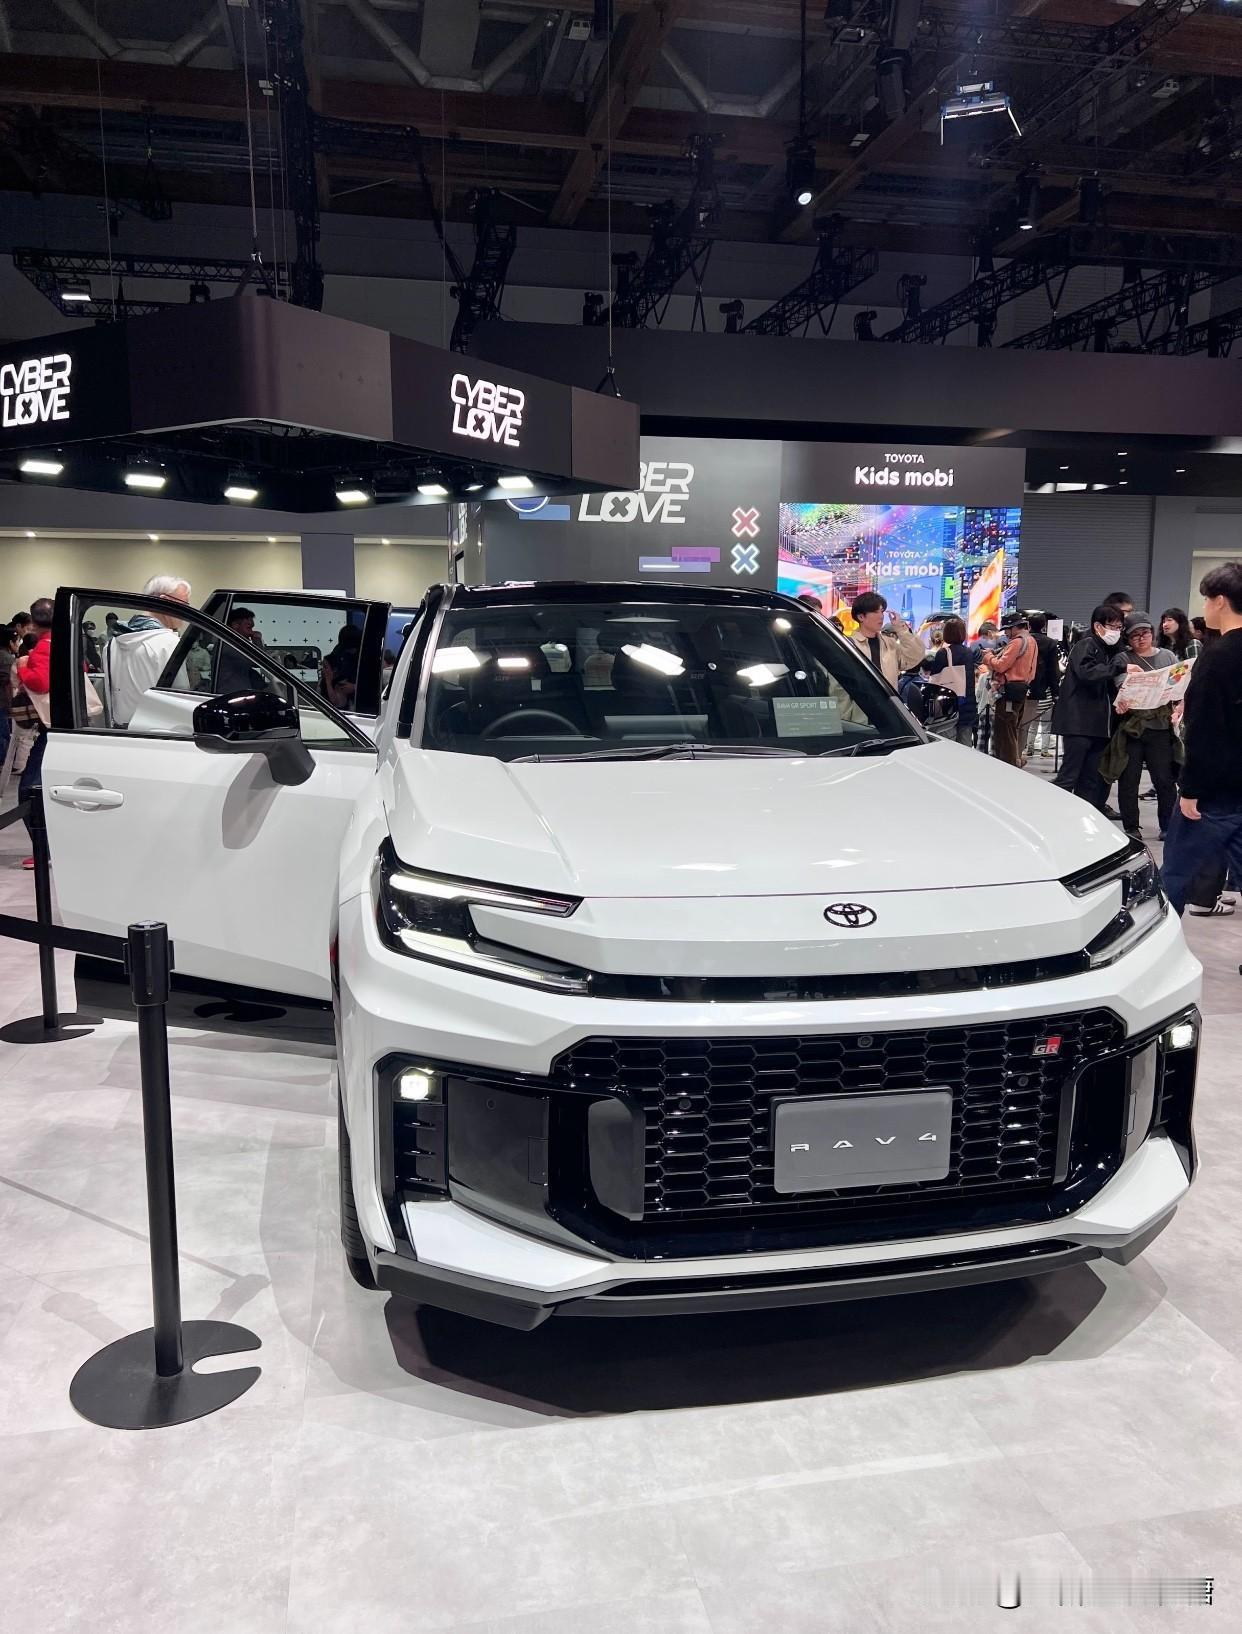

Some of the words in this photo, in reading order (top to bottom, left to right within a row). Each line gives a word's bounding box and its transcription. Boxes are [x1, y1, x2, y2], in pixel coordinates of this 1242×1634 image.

[0, 354, 72, 396] CYBER
[3, 386, 71, 427] LOVE
[451, 373, 525, 419] CYBER
[452, 403, 522, 447] LOVE
[884, 453, 925, 464] TOYOTA
[855, 466, 900, 486] Kids
[904, 468, 954, 487] mobi
[578, 491, 690, 524] LOVE
[889, 551, 921, 559] TOYOTA
[865, 561, 901, 577] Kids
[904, 562, 944, 577] mobi
[1034, 1044, 1059, 1055] GR
